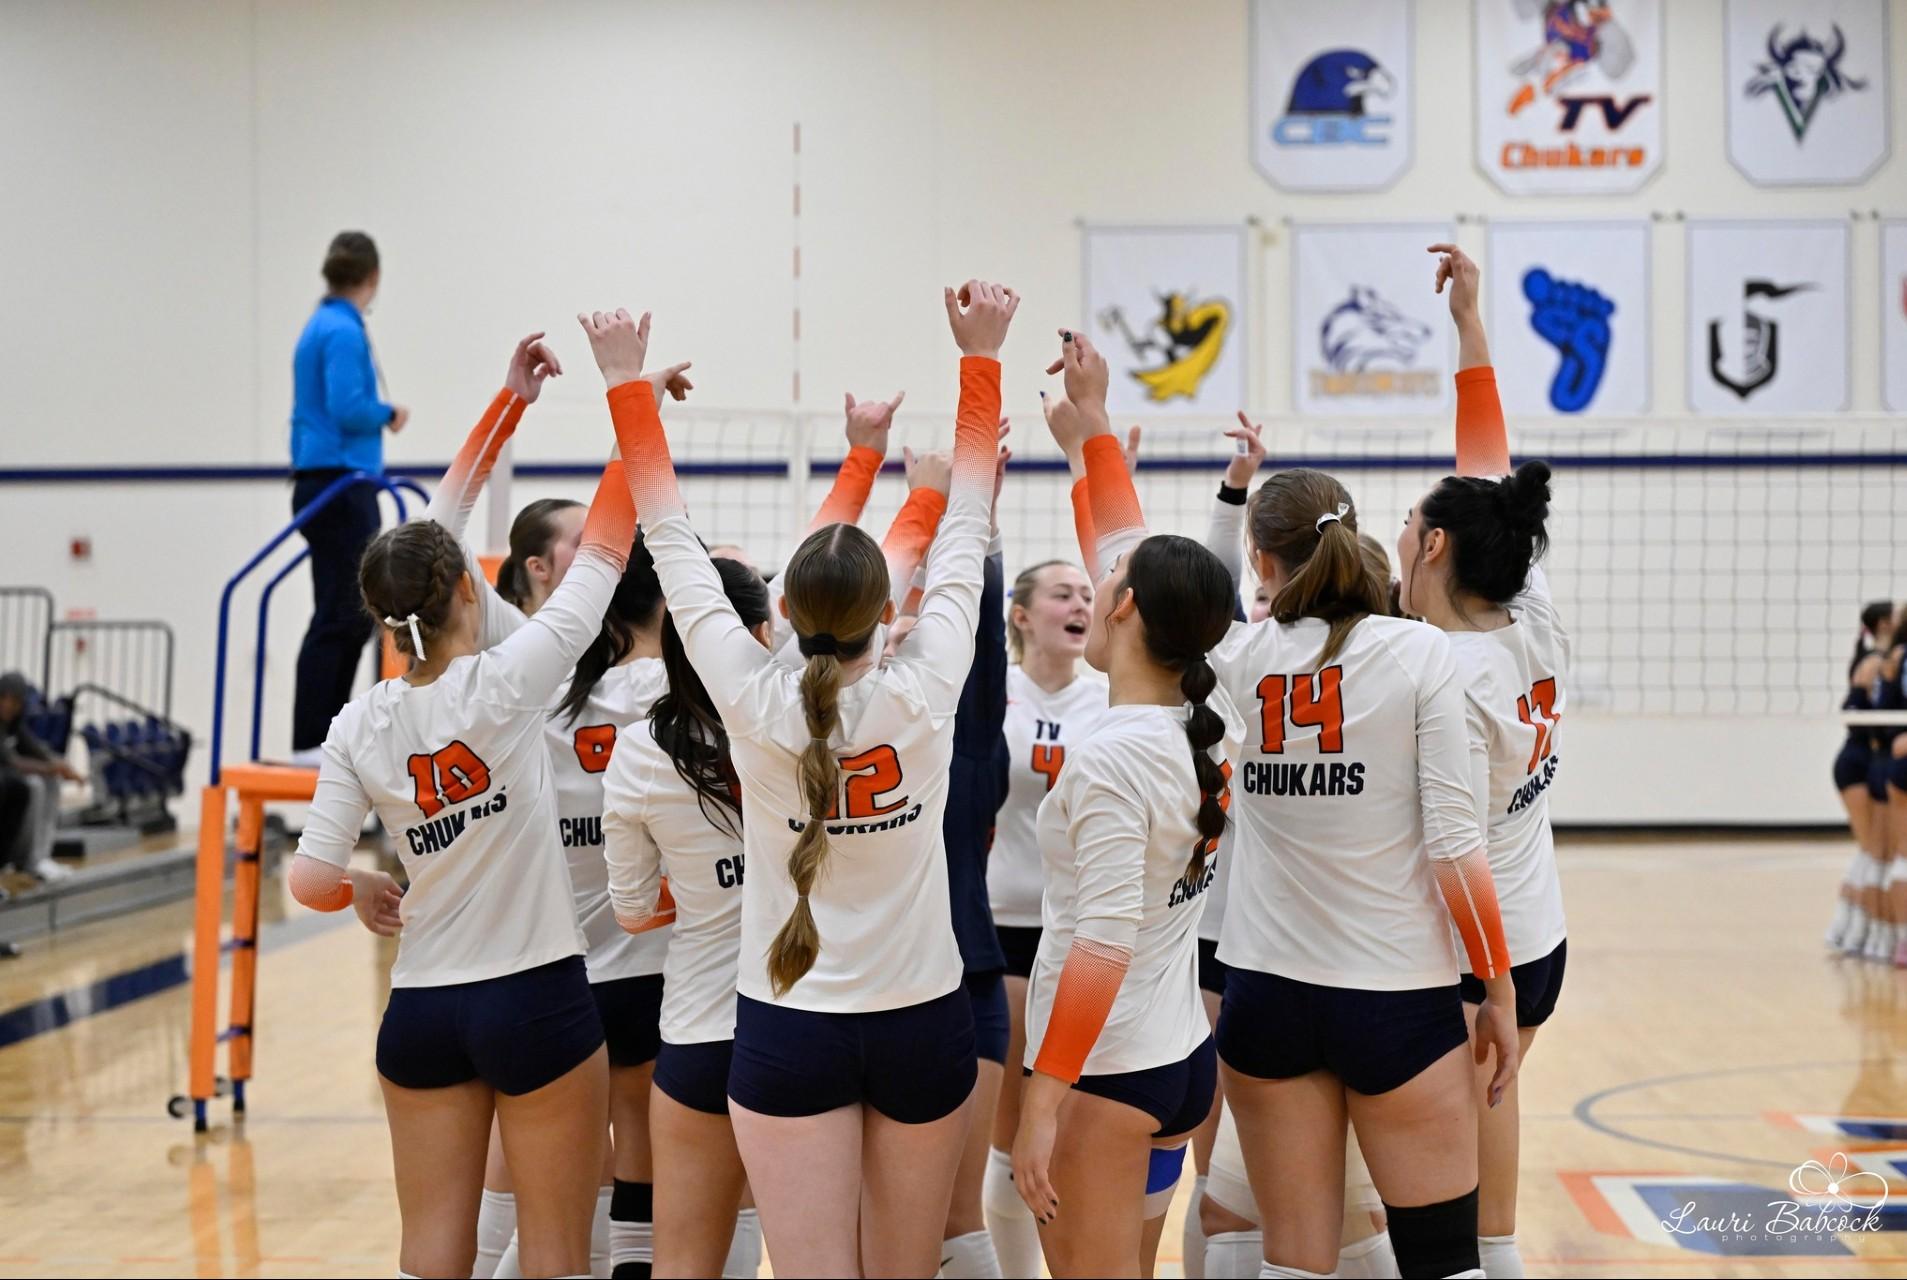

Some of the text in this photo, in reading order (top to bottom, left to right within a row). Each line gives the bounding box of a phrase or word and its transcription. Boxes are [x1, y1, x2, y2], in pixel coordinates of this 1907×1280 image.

[1557, 95, 1652, 132] TV
[1035, 718, 1061, 741] TV
[1256, 664, 1344, 754] 14
[407, 739, 491, 819] 10
[1030, 743, 1066, 793] 4
[1243, 761, 1366, 796] CHUKARS
